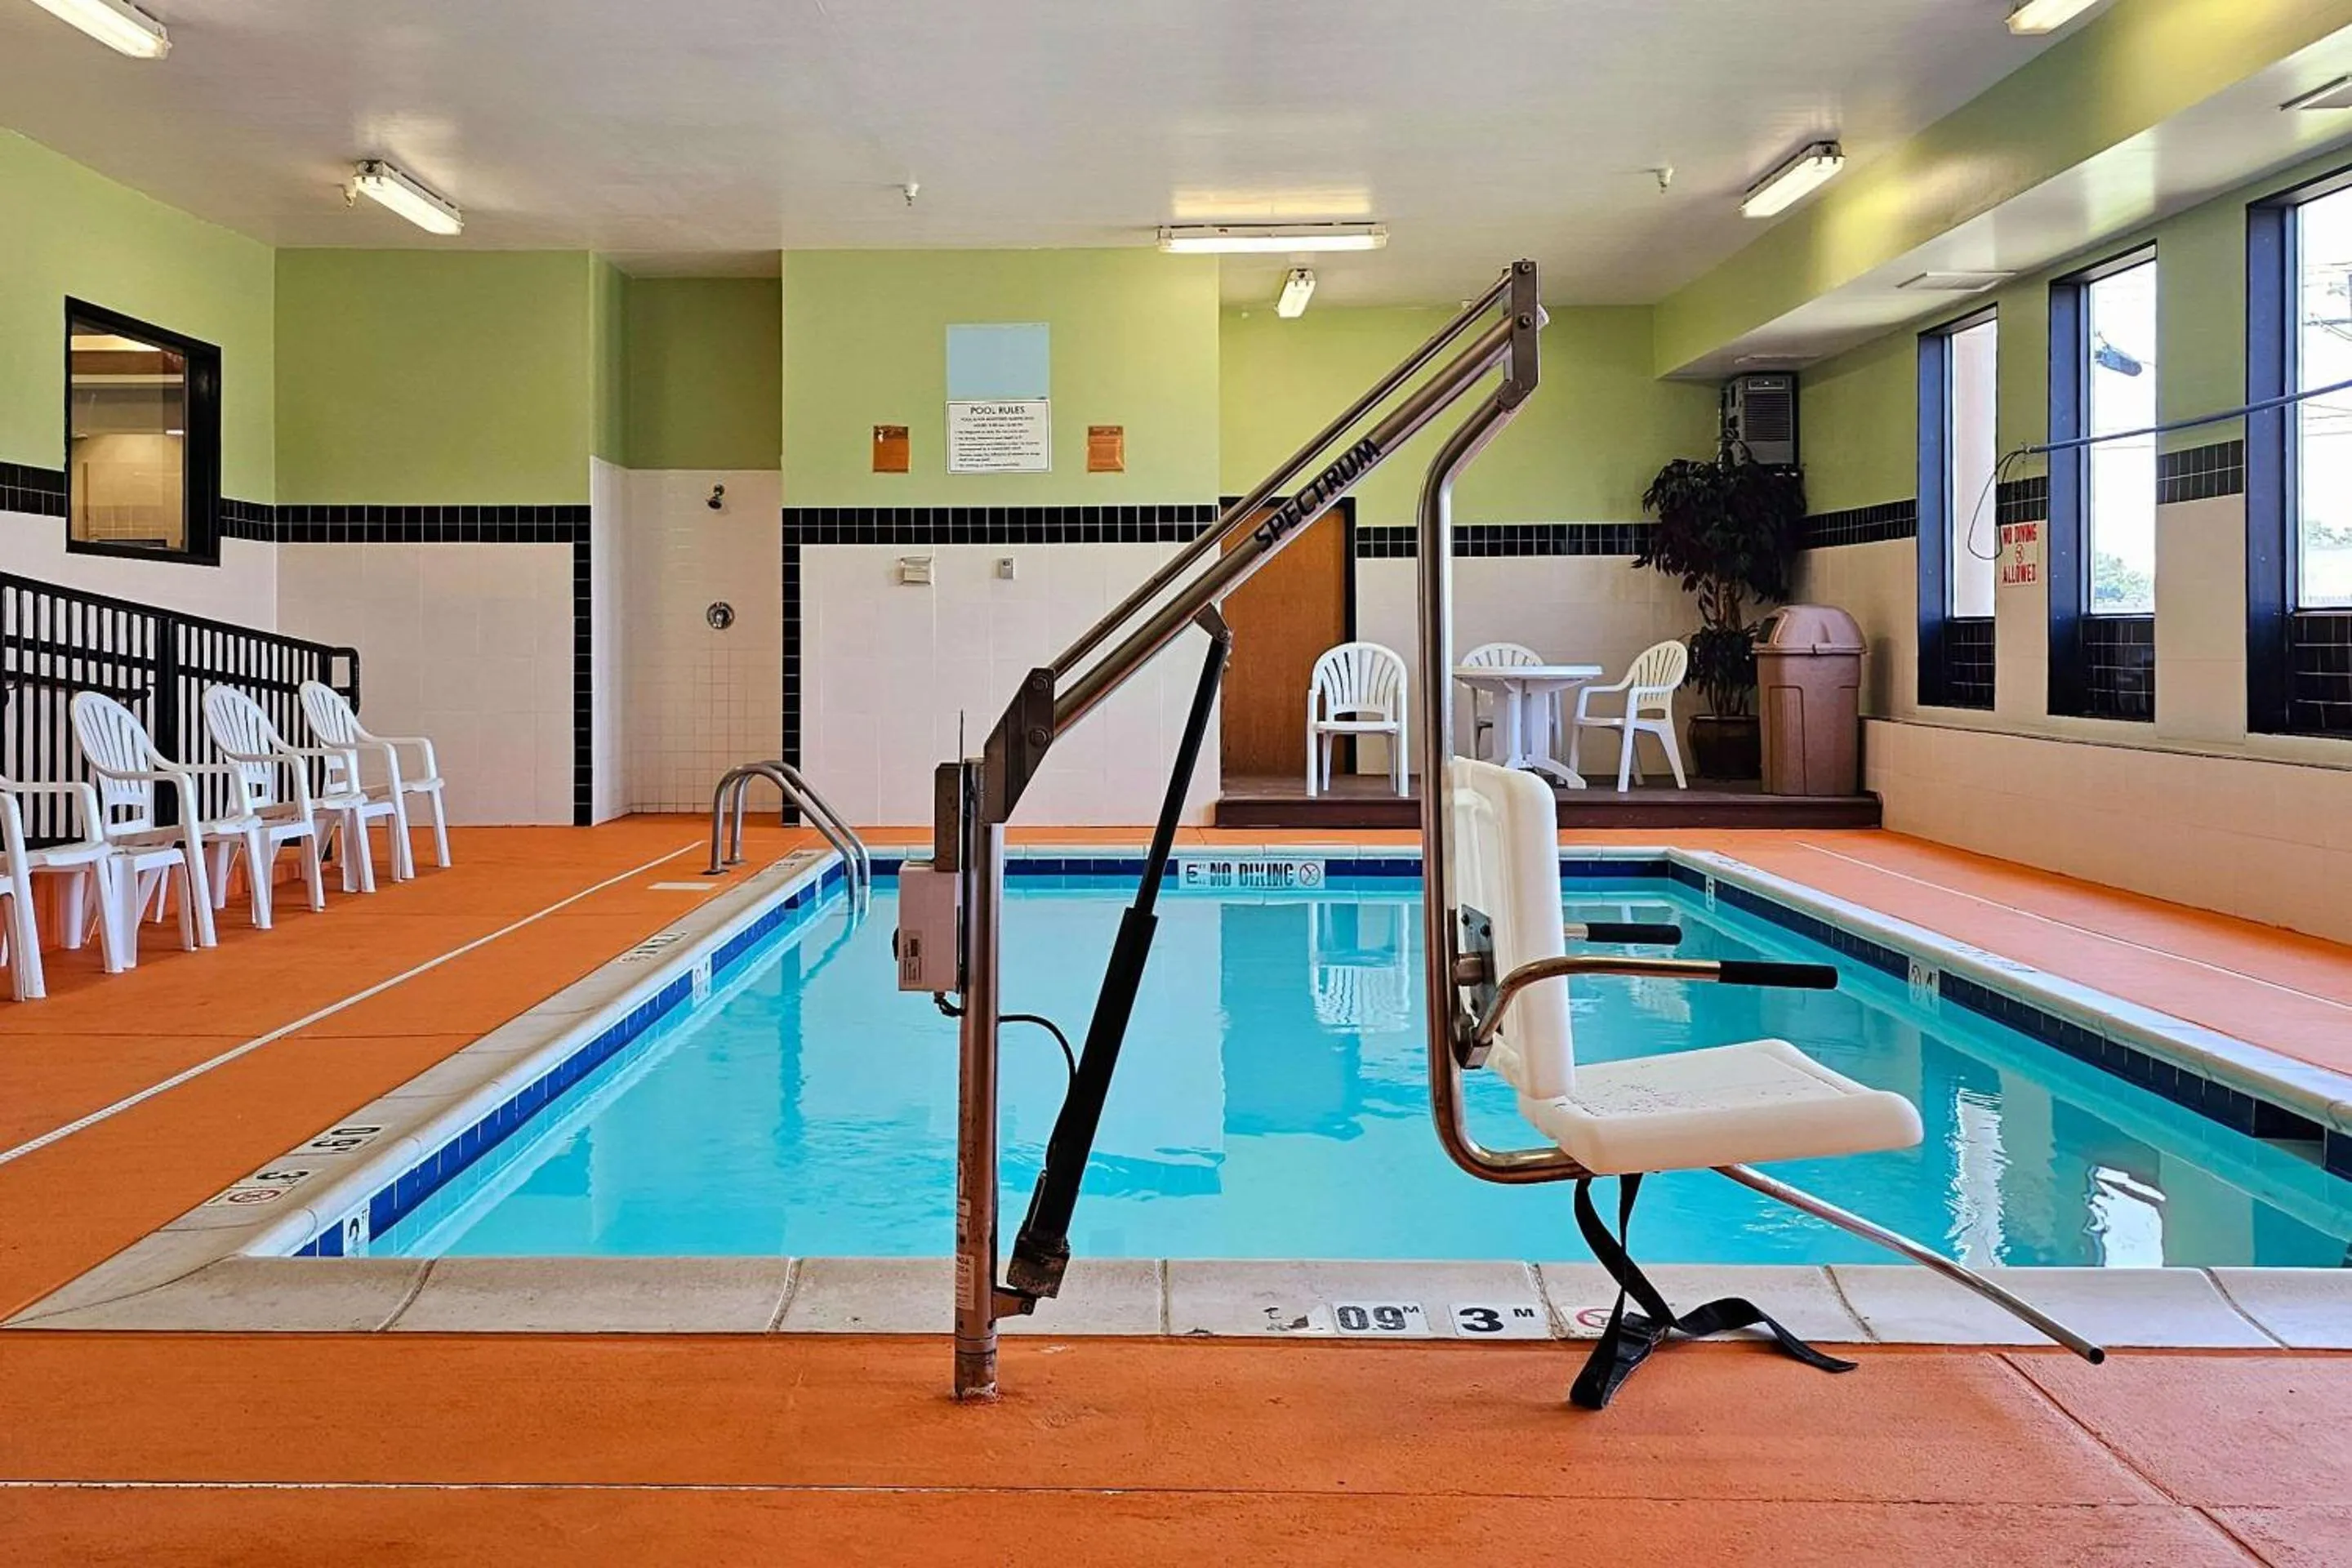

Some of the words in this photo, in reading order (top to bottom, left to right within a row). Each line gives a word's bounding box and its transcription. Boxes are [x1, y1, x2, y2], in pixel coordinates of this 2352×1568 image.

[970, 406, 996, 414] POOL
[999, 405, 1025, 414] RULES
[1254, 438, 1382, 556] SPECTRUM
[1459, 1307, 1504, 1332] 3
[1513, 1308, 1535, 1317] M
